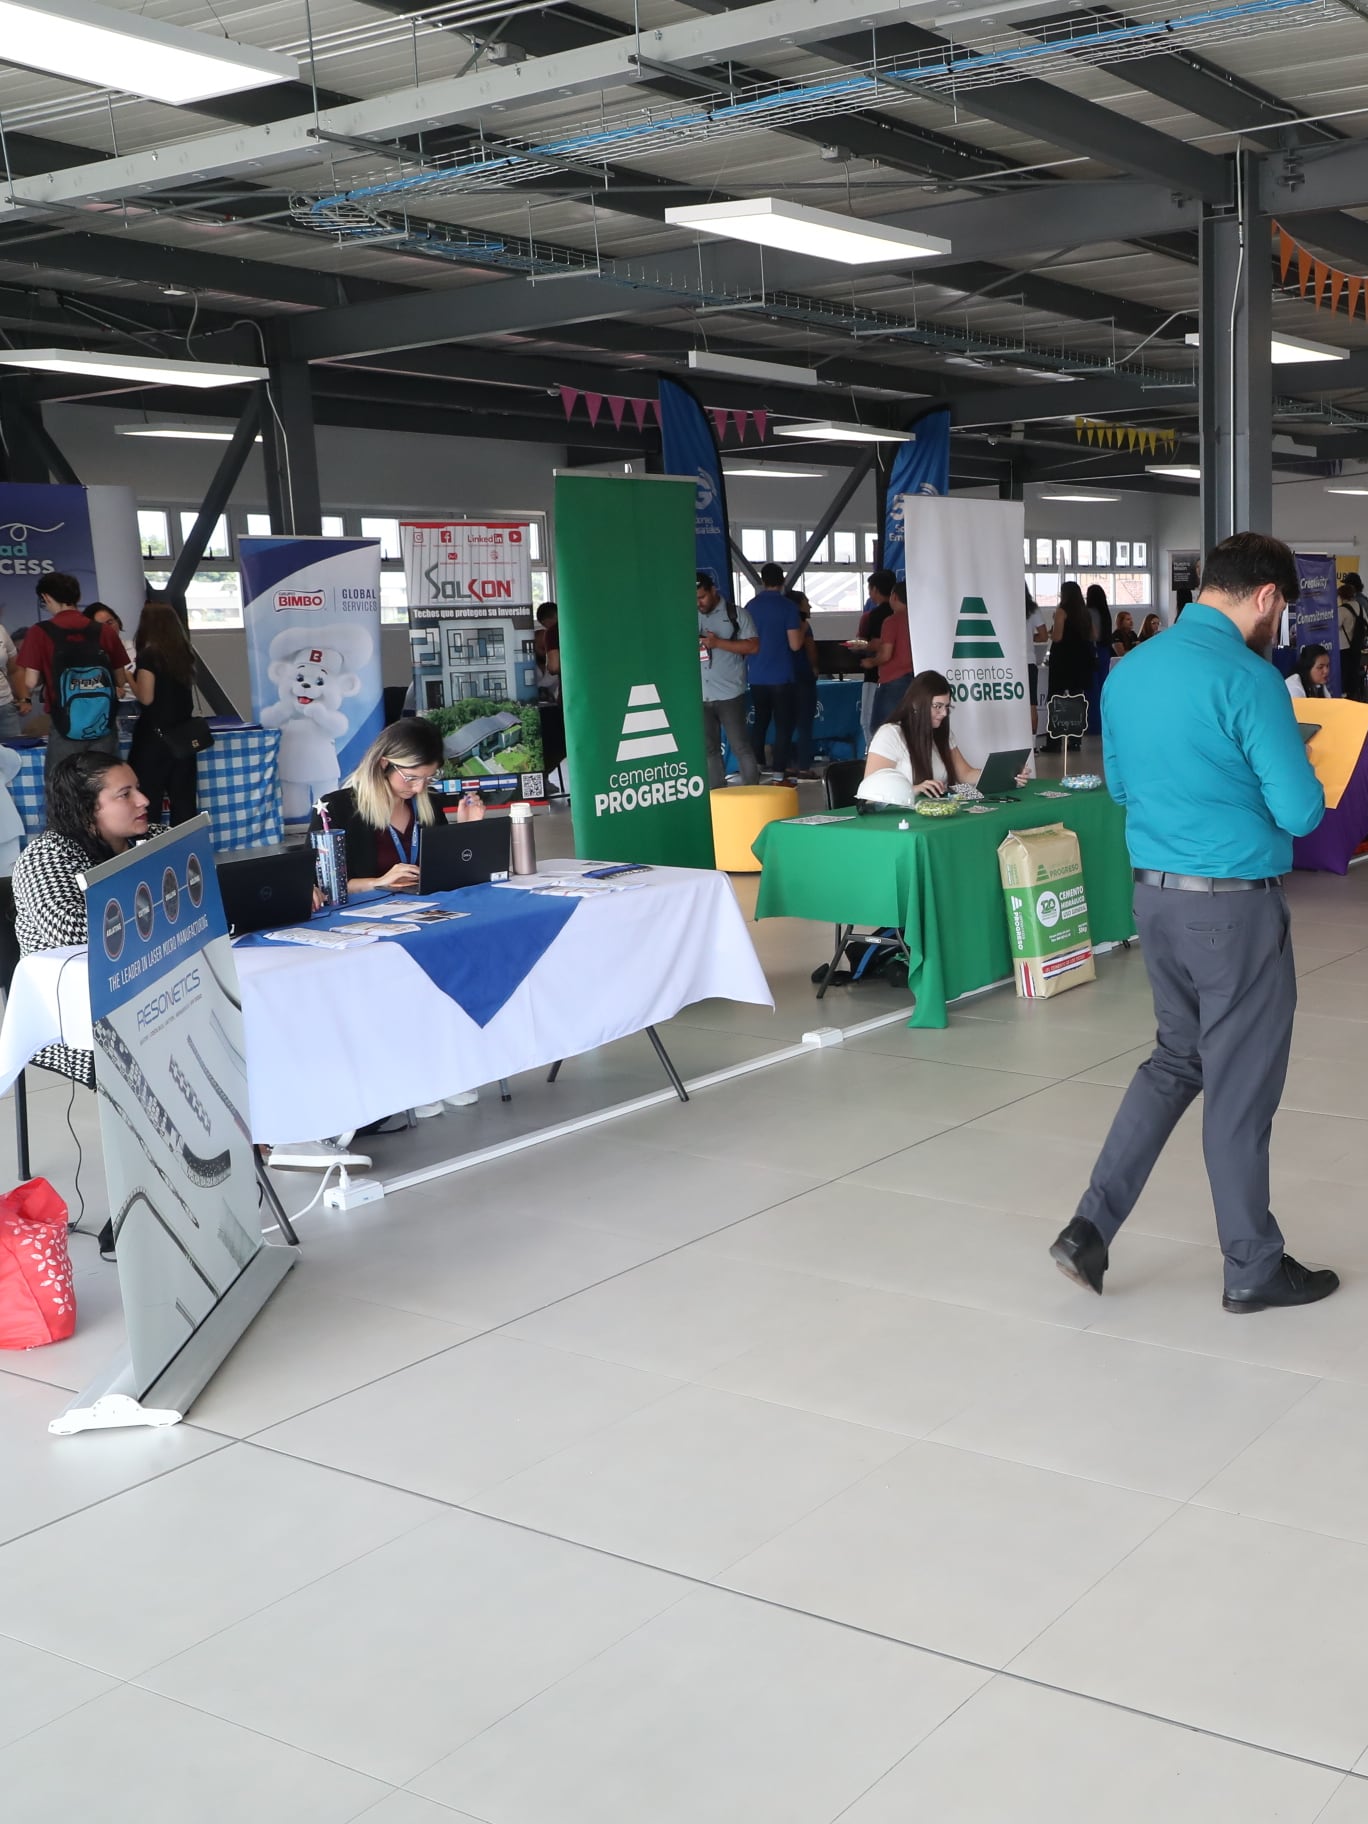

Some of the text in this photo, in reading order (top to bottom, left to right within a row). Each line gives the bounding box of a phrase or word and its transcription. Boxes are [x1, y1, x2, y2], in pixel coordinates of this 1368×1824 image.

[1300, 576, 1328, 590] Creativity
[278, 596, 322, 607] BIMBO
[342, 588, 377, 600] GLOBAL
[342, 600, 378, 612] SERVICES
[413, 608, 438, 618] Techos
[440, 608, 454, 619] que
[455, 606, 486, 618] protegen
[488, 606, 497, 615] su
[1297, 609, 1334, 625] Commitment
[946, 666, 1013, 681] cementos
[948, 681, 1025, 702] ROGRESO
[609, 761, 688, 788] cementos
[594, 775, 704, 817] PROGRESO
[1049, 863, 1079, 878] PROGRESO
[1059, 885, 1084, 901] CEMENTO
[1013, 911, 1023, 951] PROGRESO
[108, 914, 209, 993] THE LEADER IN LASER MICRO MANUFACTURING
[136, 968, 201, 1032] RESONETICS
